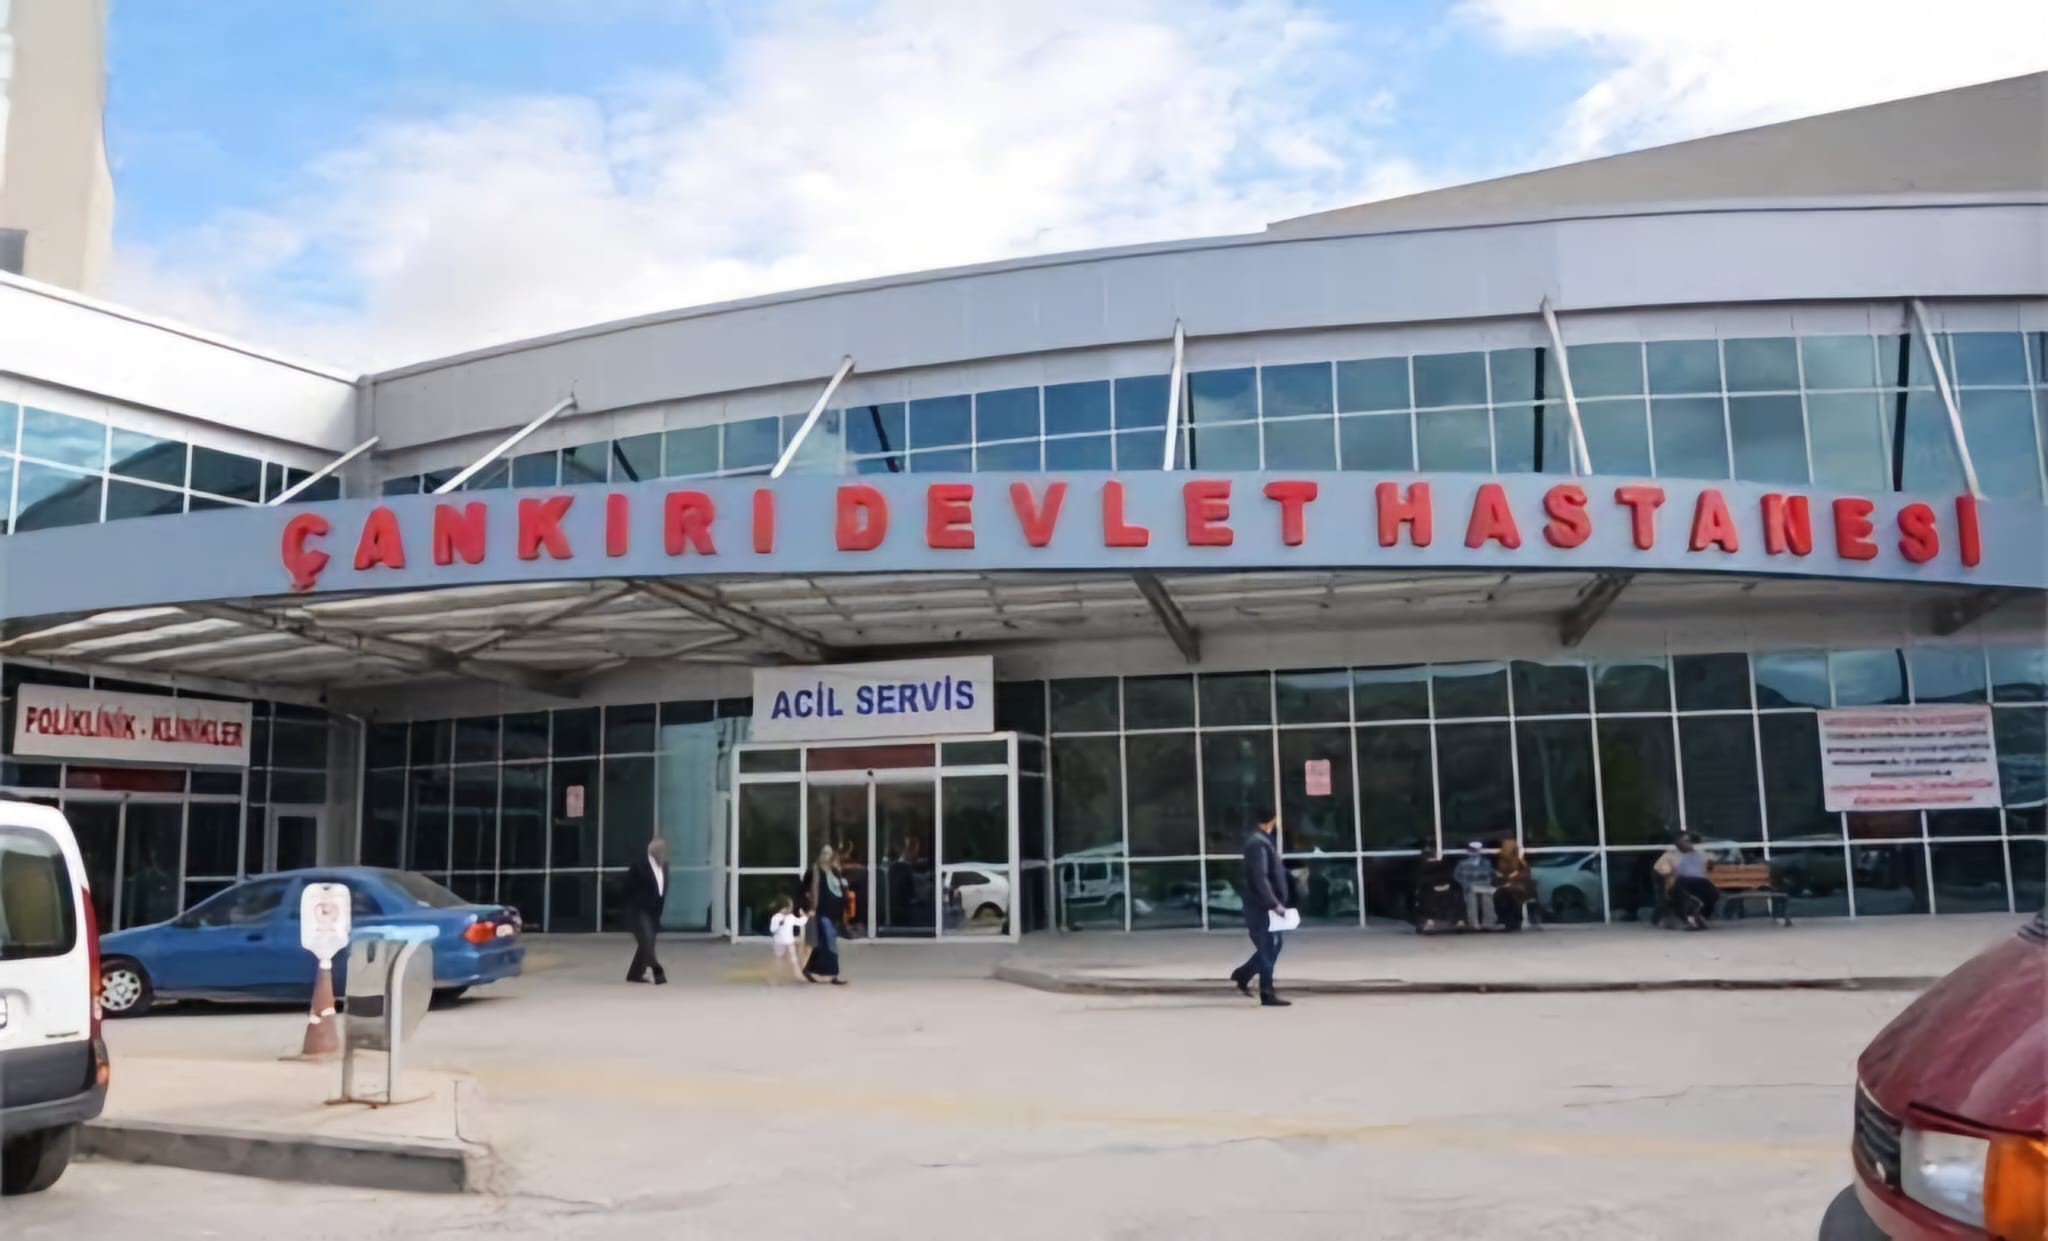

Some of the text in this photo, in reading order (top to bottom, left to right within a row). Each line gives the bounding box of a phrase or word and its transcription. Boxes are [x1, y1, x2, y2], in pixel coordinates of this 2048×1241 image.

[282, 489, 776, 591] ÇANKIRI
[835, 480, 1319, 551] DEVLET
[771, 675, 975, 720] ACİL SERVİS
